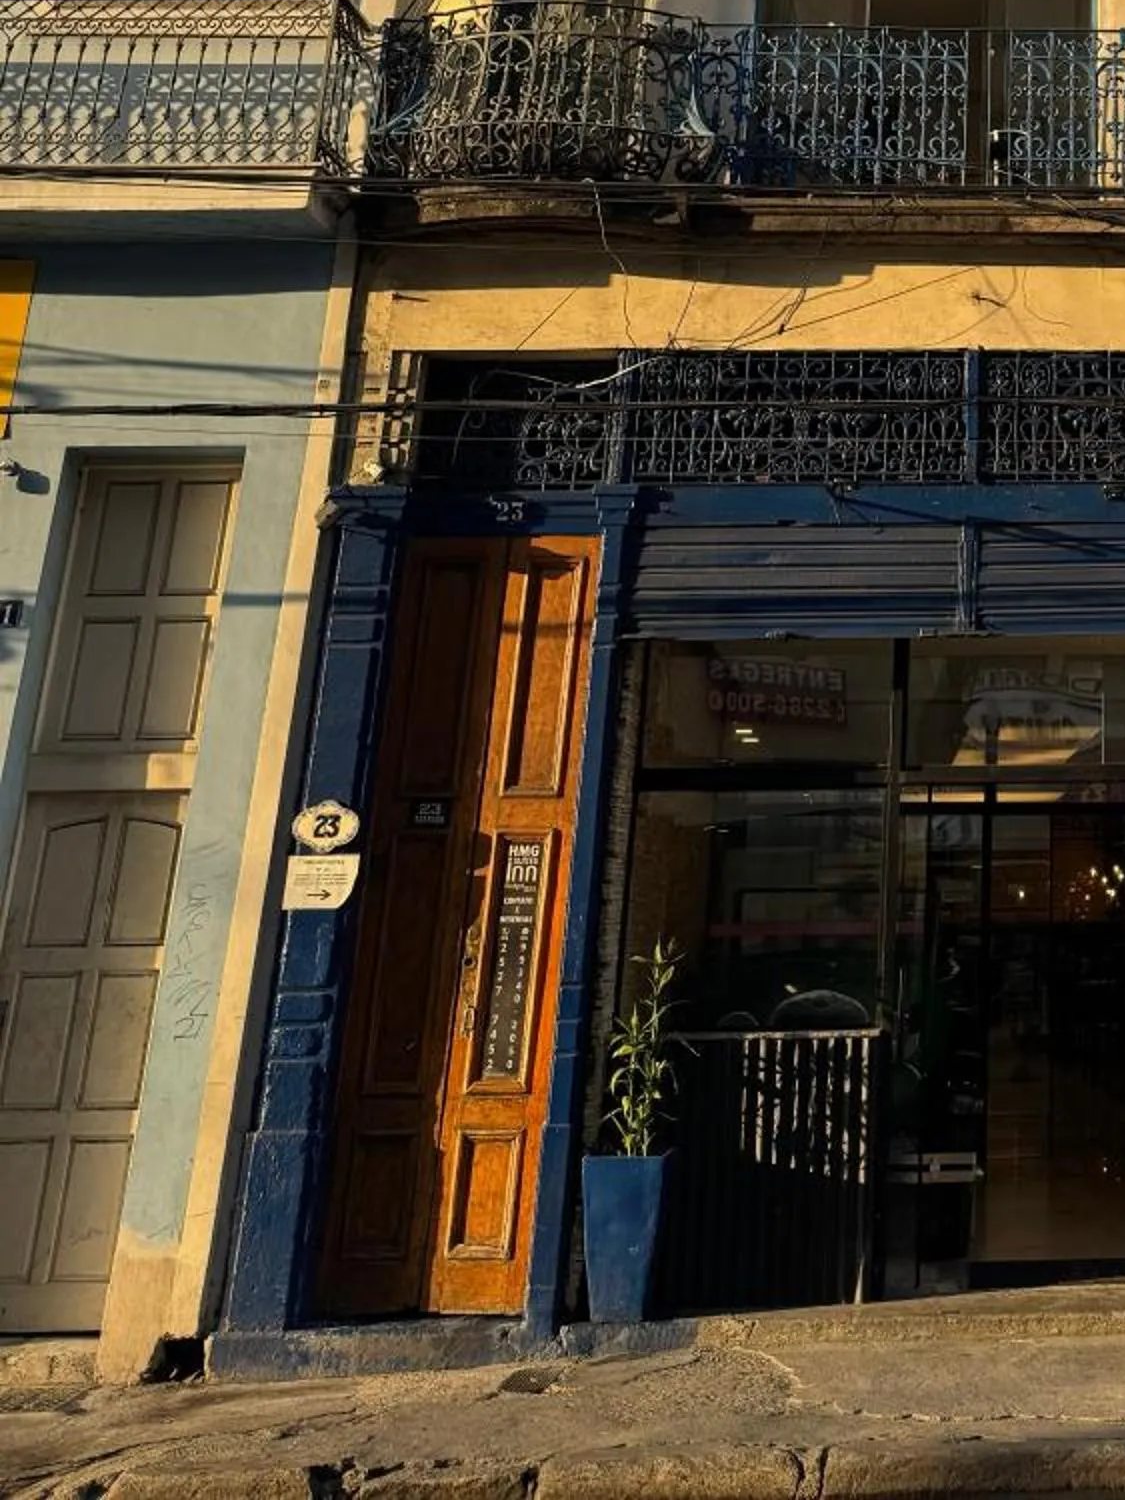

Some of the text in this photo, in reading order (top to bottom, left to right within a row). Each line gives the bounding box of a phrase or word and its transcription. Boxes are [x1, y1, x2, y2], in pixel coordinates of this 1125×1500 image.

[496, 501, 524, 521] 23
[313, 814, 341, 838] 23
[508, 844, 540, 857] HMG
